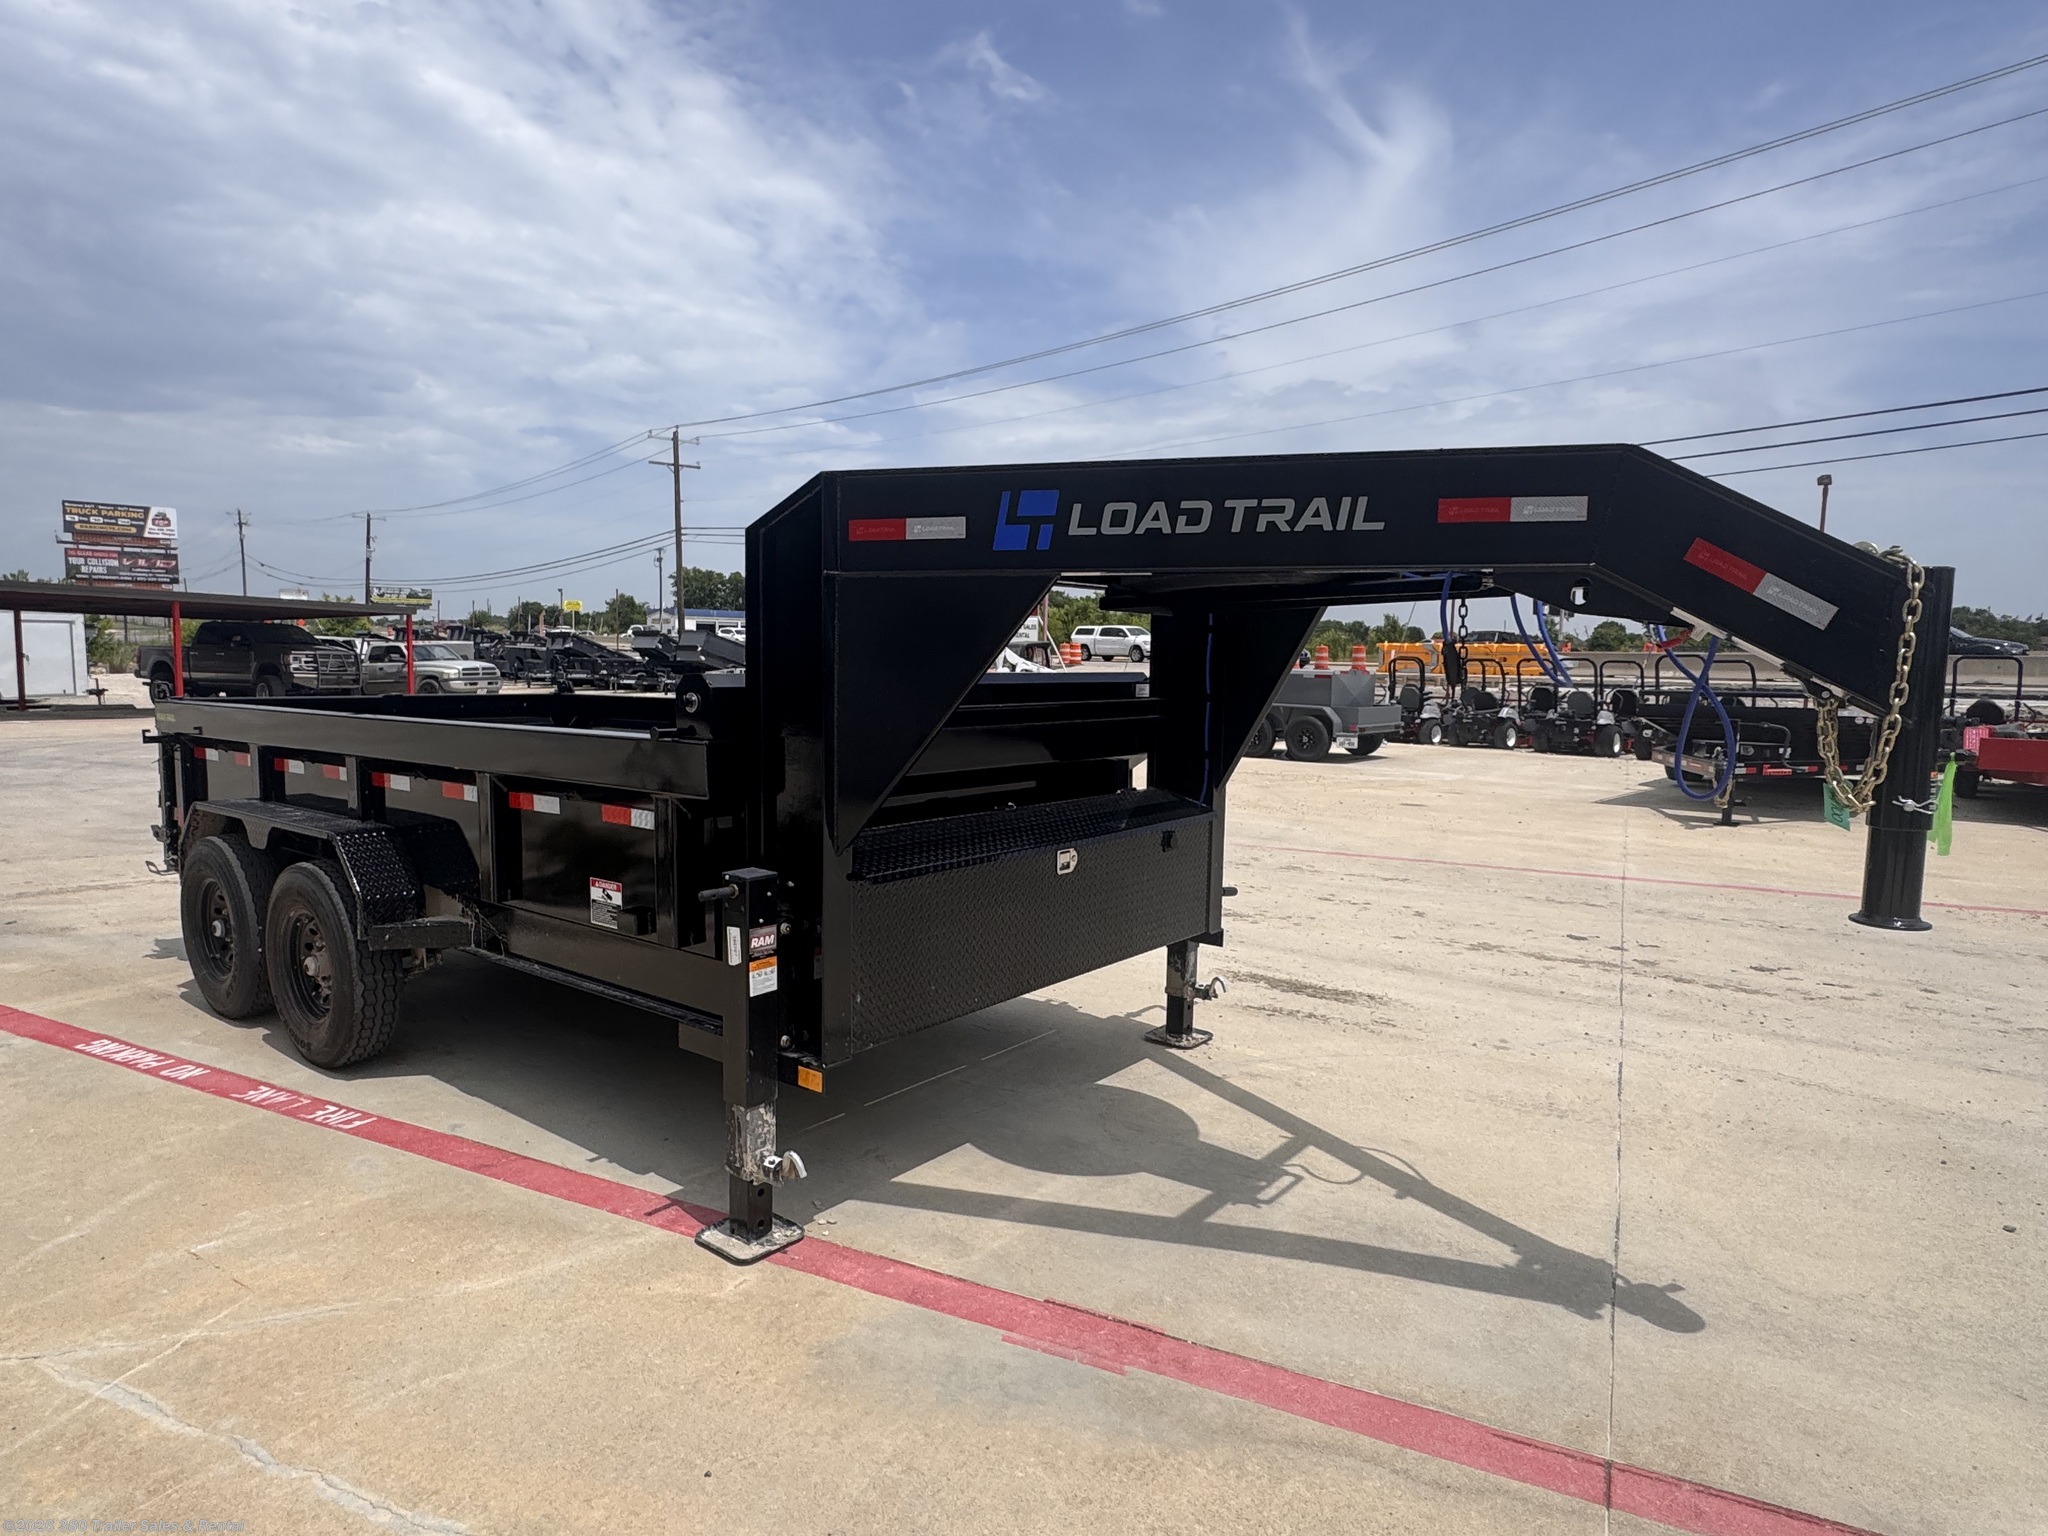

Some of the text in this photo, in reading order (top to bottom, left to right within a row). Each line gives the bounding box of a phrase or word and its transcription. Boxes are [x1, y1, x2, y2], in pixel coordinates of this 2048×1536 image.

[65, 506, 98, 515] TRUCK
[101, 509, 145, 519] PARKING
[1067, 496, 1386, 536] LOAD TRAIL
[68, 557, 85, 565] YOUR
[87, 557, 119, 567] COLLISION
[81, 565, 108, 574] REPAIRS
[750, 934, 775, 949] RAM
[74, 1038, 378, 1130] FIRE LANE NO PARKING
